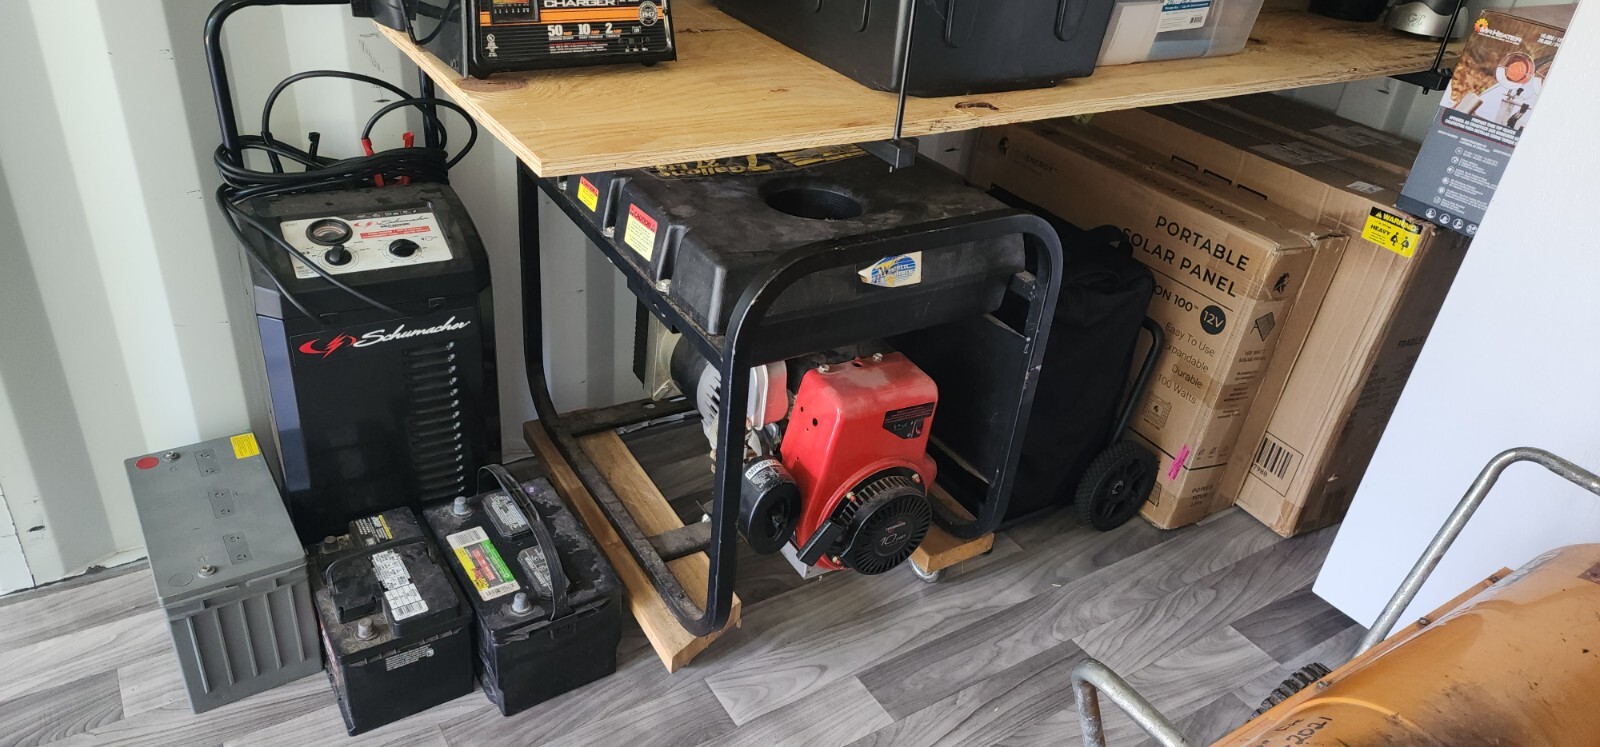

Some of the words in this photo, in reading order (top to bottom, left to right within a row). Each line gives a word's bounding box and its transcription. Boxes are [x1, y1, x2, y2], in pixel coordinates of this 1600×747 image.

[547, 25, 563, 36] 50
[578, 24, 591, 35] 10
[605, 22, 613, 34] 2
[1155, 215, 1250, 272] PORTABLE
[1370, 224, 1391, 236] HEAVY
[1123, 227, 1176, 265] SOLAR
[1179, 257, 1236, 298] PANEL
[353, 315, 471, 348] Schumacher
[1203, 310, 1225, 328] 12V
[1165, 322, 1185, 341] Easy
[1188, 333, 1198, 346] To
[1198, 341, 1216, 357] Use
[1164, 338, 1209, 373] xpandable
[1158, 374, 1172, 389] 100
[1173, 383, 1197, 404] Watts
[1171, 364, 1203, 389] Durable
[1286, 716, 1333, 745] 2021
